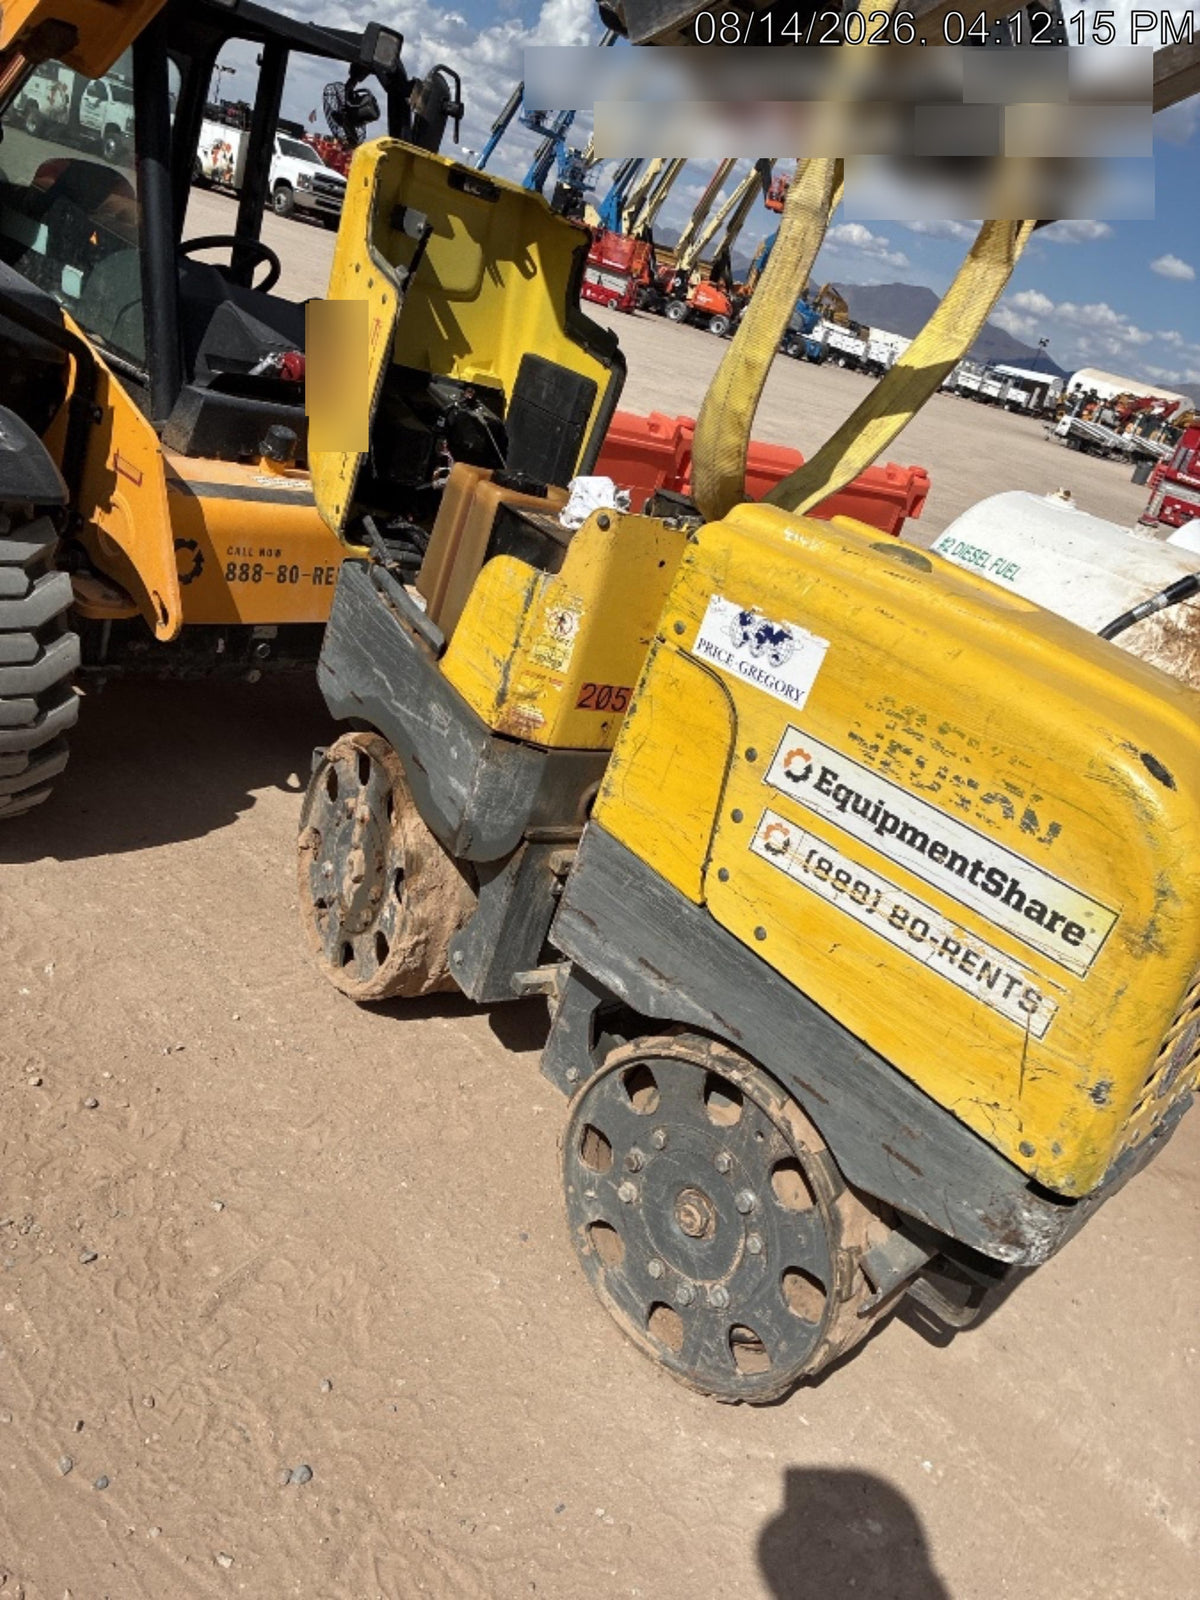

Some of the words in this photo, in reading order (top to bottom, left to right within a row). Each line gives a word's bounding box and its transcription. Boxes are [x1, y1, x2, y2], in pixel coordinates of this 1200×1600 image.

[226, 546, 254, 557] CALL
[951, 541, 992, 569] DIESEL
[988, 557, 1021, 582] FUEL
[225, 562, 339, 586] 888-80-RE
[696, 638, 735, 664] PRICE
[739, 660, 805, 702] GREGORY
[577, 683, 631, 711] 205
[813, 765, 1086, 948] EquipmentShare
[803, 848, 882, 914] (888)
[887, 902, 1044, 1015] 80-RENTS
